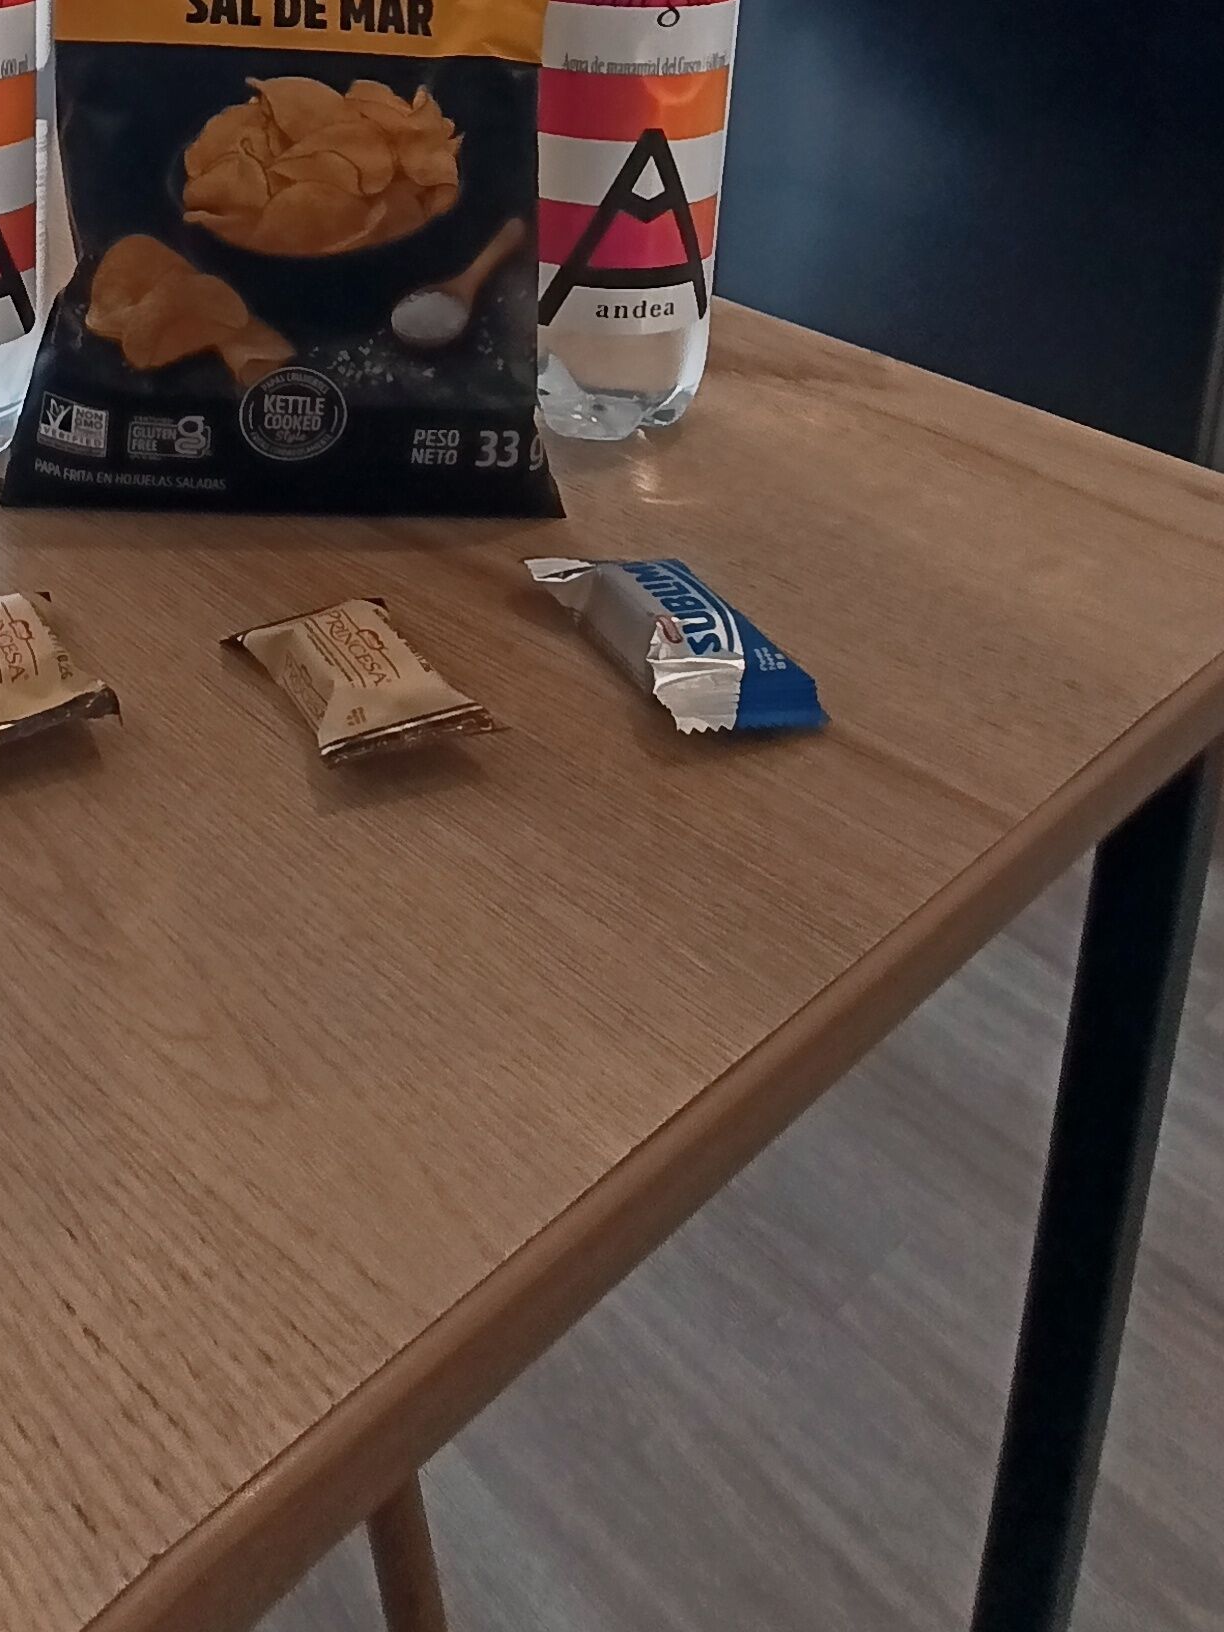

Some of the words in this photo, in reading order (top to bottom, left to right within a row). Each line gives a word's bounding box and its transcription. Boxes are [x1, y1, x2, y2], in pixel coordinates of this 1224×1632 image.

[595, 300, 676, 320] andea
[75, 407, 104, 420] NON
[263, 394, 326, 416] KETTLE
[74, 418, 104, 430] GMO
[263, 413, 322, 431] COOKED
[132, 425, 177, 441] GLUTEN
[413, 429, 460, 447] PESO
[131, 438, 158, 452] FREE
[475, 430, 521, 467] 33
[410, 447, 458, 465] NETO
[34, 457, 62, 477] PAPA
[63, 467, 94, 483] FRITA
[96, 471, 113, 485] EN
[115, 472, 173, 488] HOJUELAS
[176, 475, 227, 490] SALADAS
